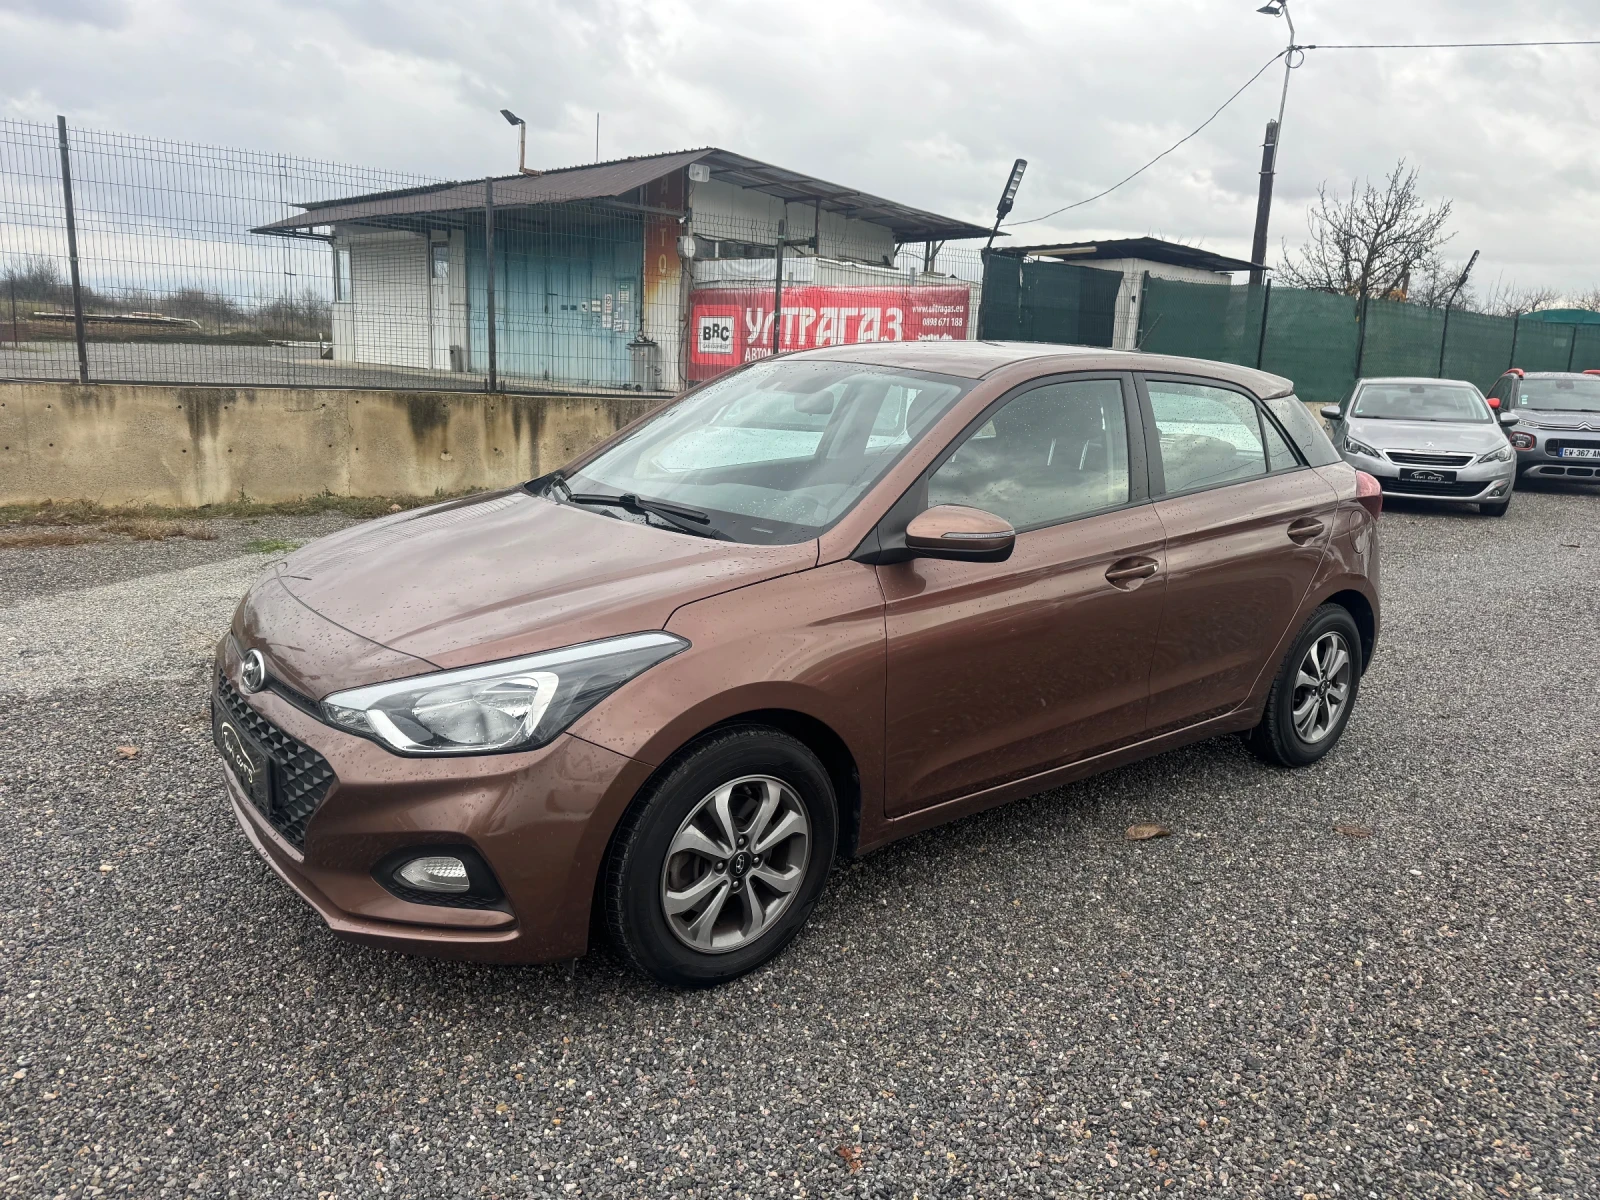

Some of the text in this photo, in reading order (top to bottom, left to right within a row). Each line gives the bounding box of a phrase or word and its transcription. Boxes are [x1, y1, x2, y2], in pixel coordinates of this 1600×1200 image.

[938, 317, 950, 327] 671
[951, 317, 963, 327] 188
[702, 323, 730, 342] BRC
